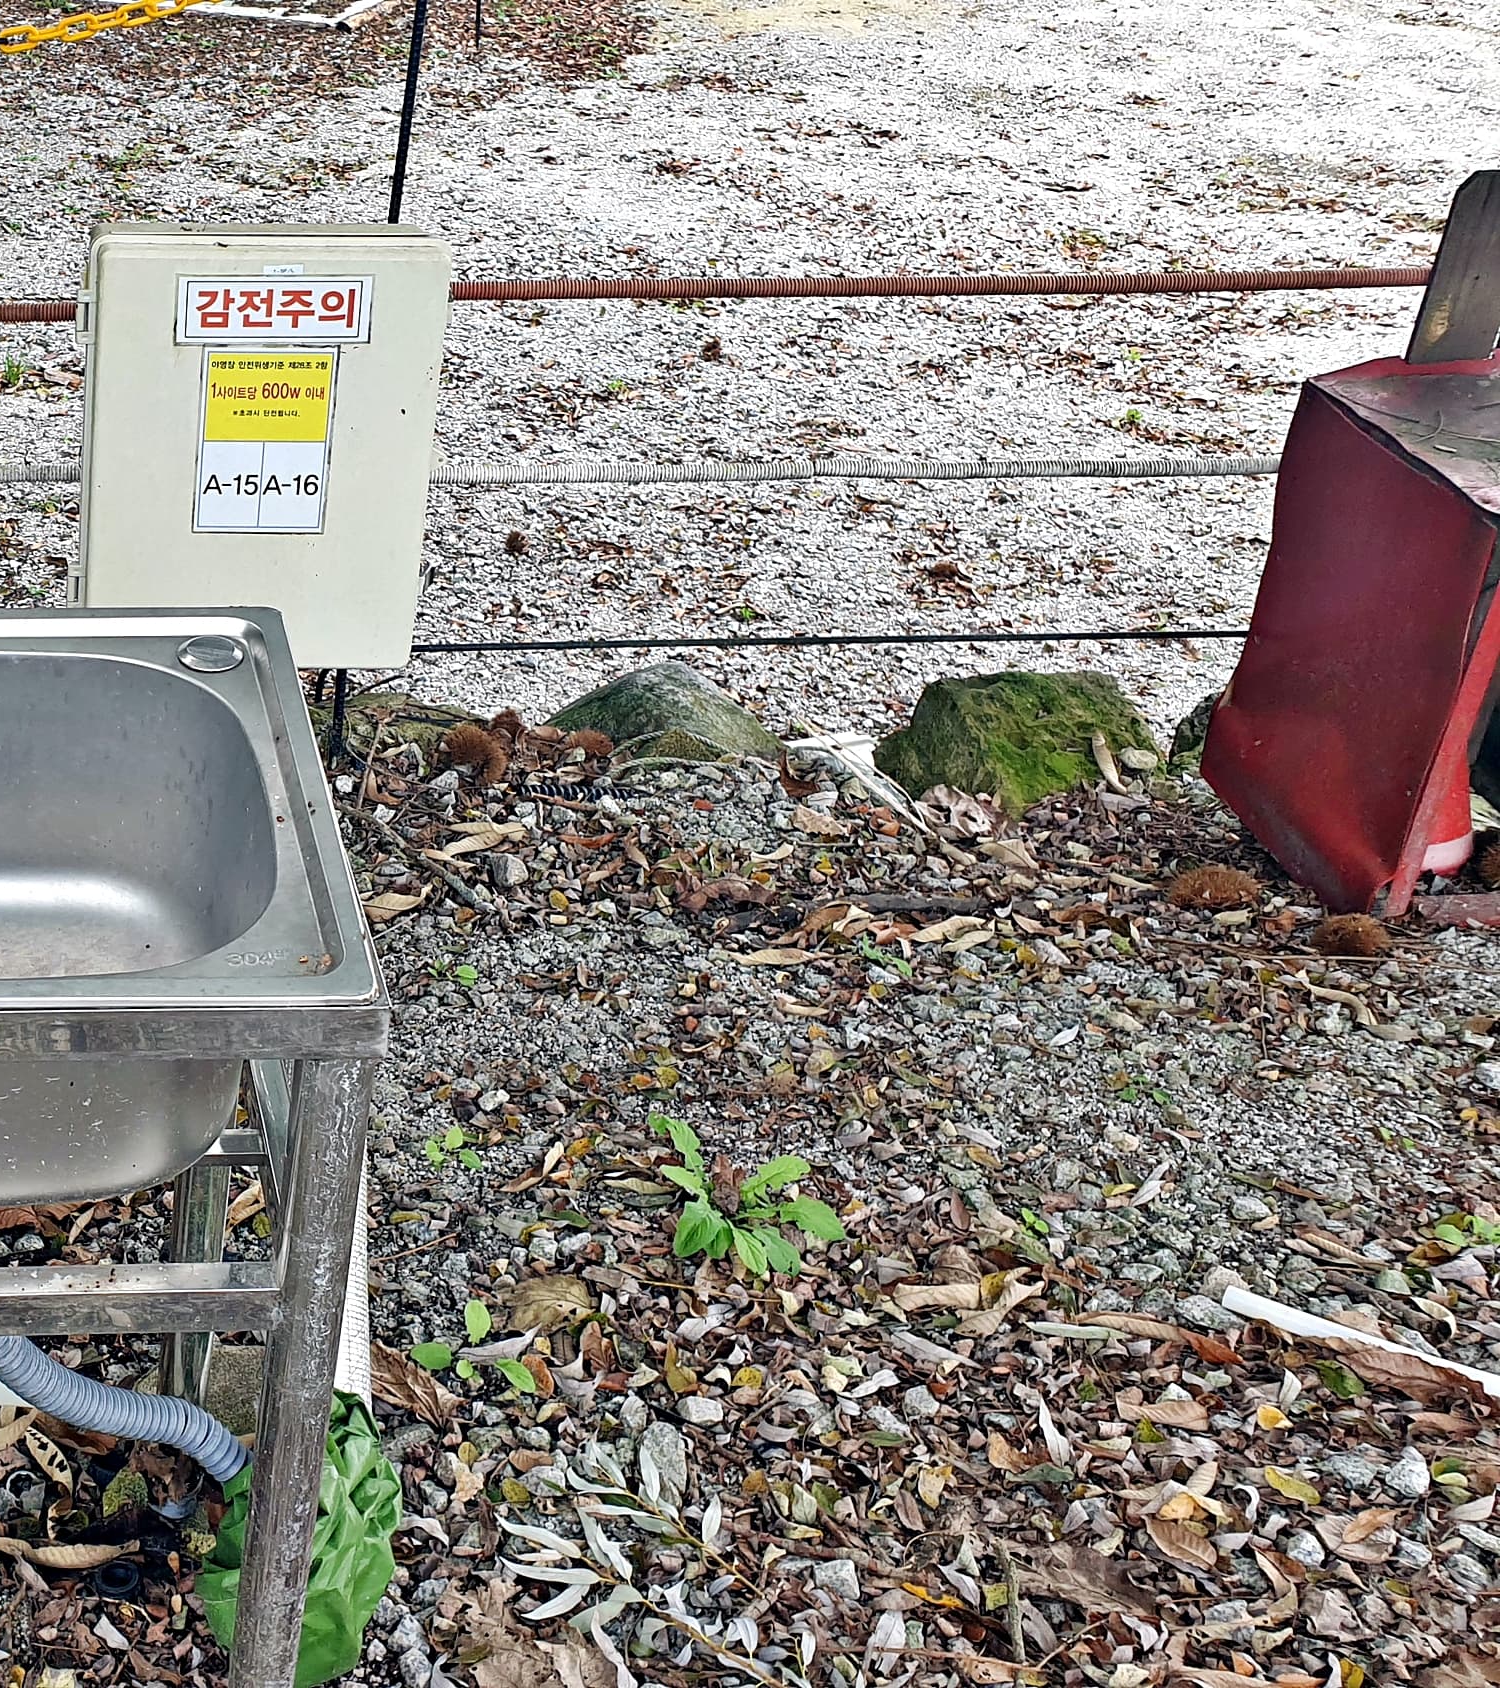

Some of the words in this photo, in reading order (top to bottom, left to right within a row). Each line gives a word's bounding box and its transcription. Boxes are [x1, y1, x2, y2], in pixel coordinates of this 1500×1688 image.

[195, 288, 356, 328] 감전주의
[211, 382, 257, 400] 1사이트당
[305, 386, 325, 400] 이내
[202, 474, 259, 496] A-15
[262, 474, 319, 496] A-16
